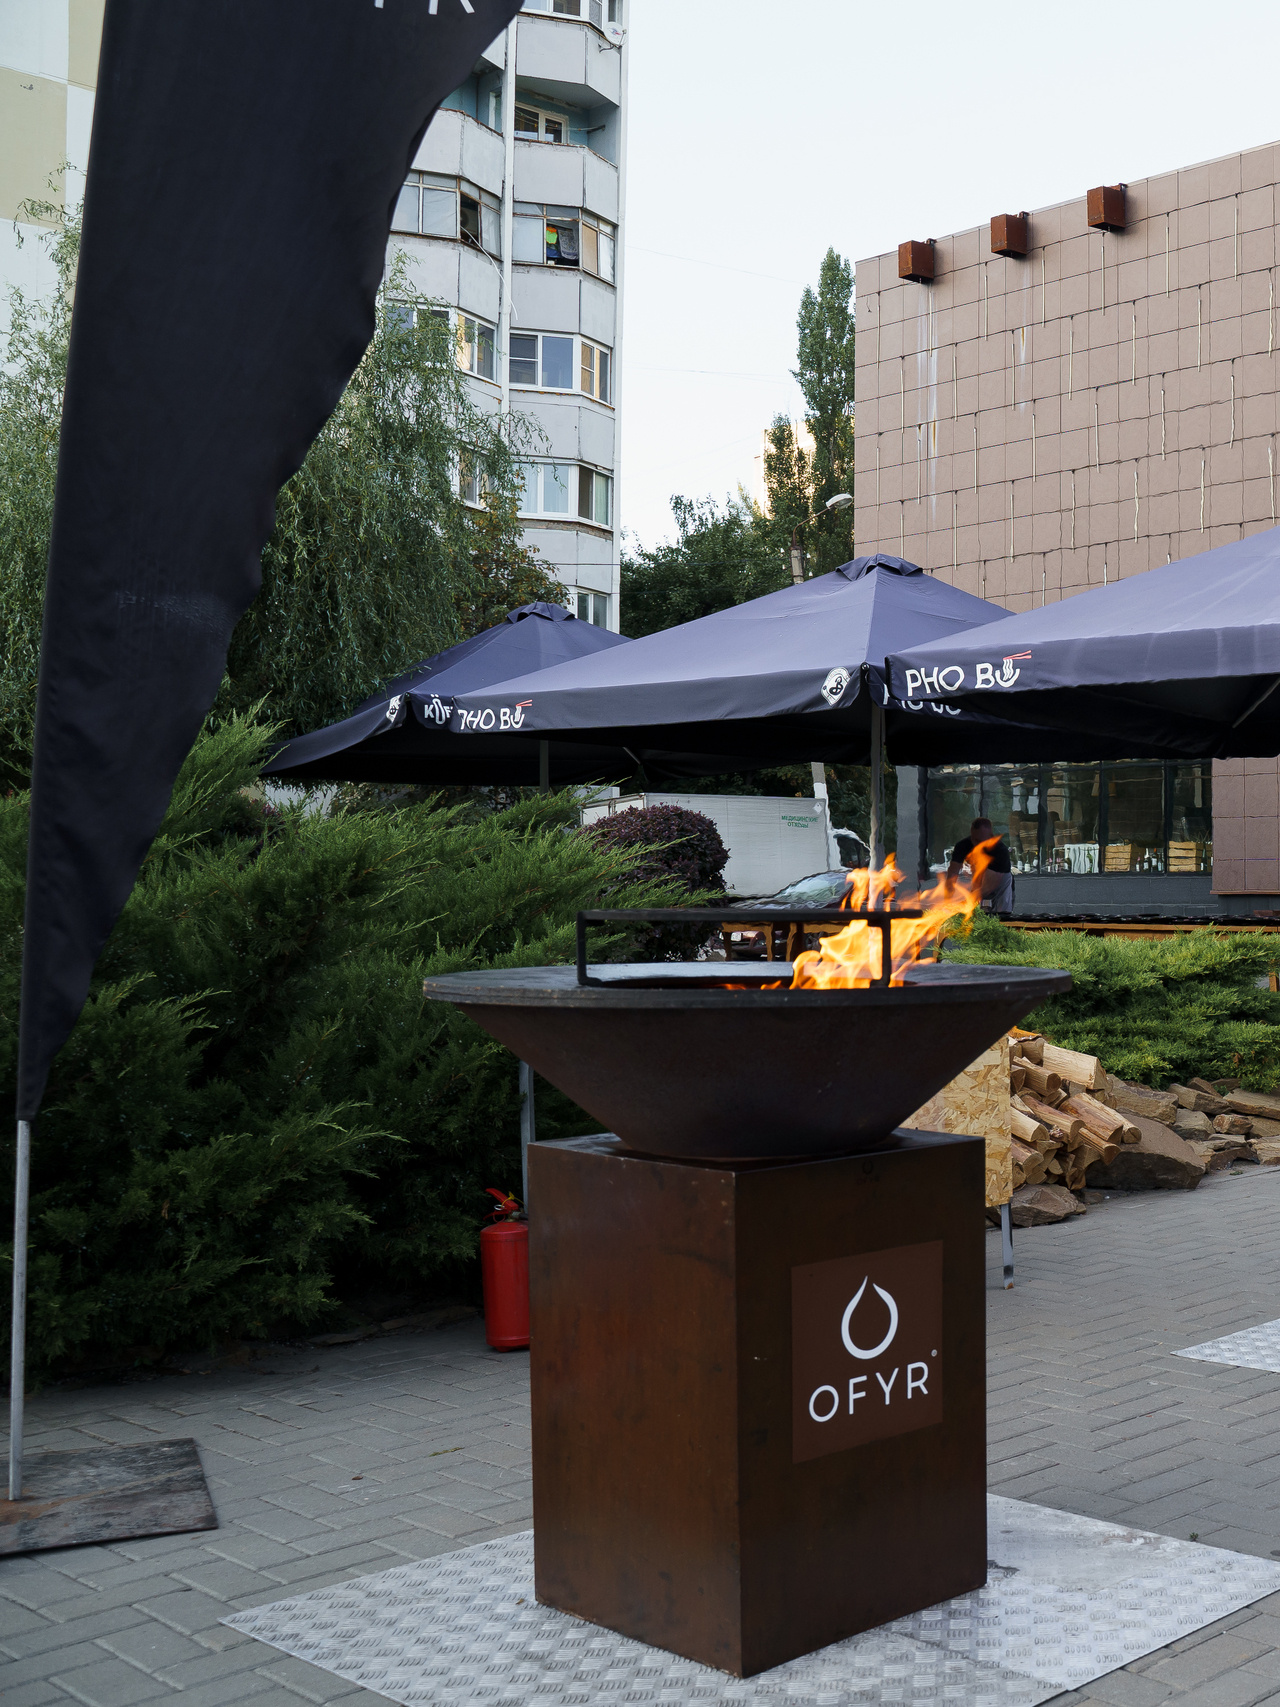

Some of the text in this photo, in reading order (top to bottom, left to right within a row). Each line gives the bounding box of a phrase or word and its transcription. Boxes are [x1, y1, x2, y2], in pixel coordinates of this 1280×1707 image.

[905, 660, 1021, 697] PHO BU
[499, 707, 526, 729] BU
[808, 1361, 929, 1423] OFYR
